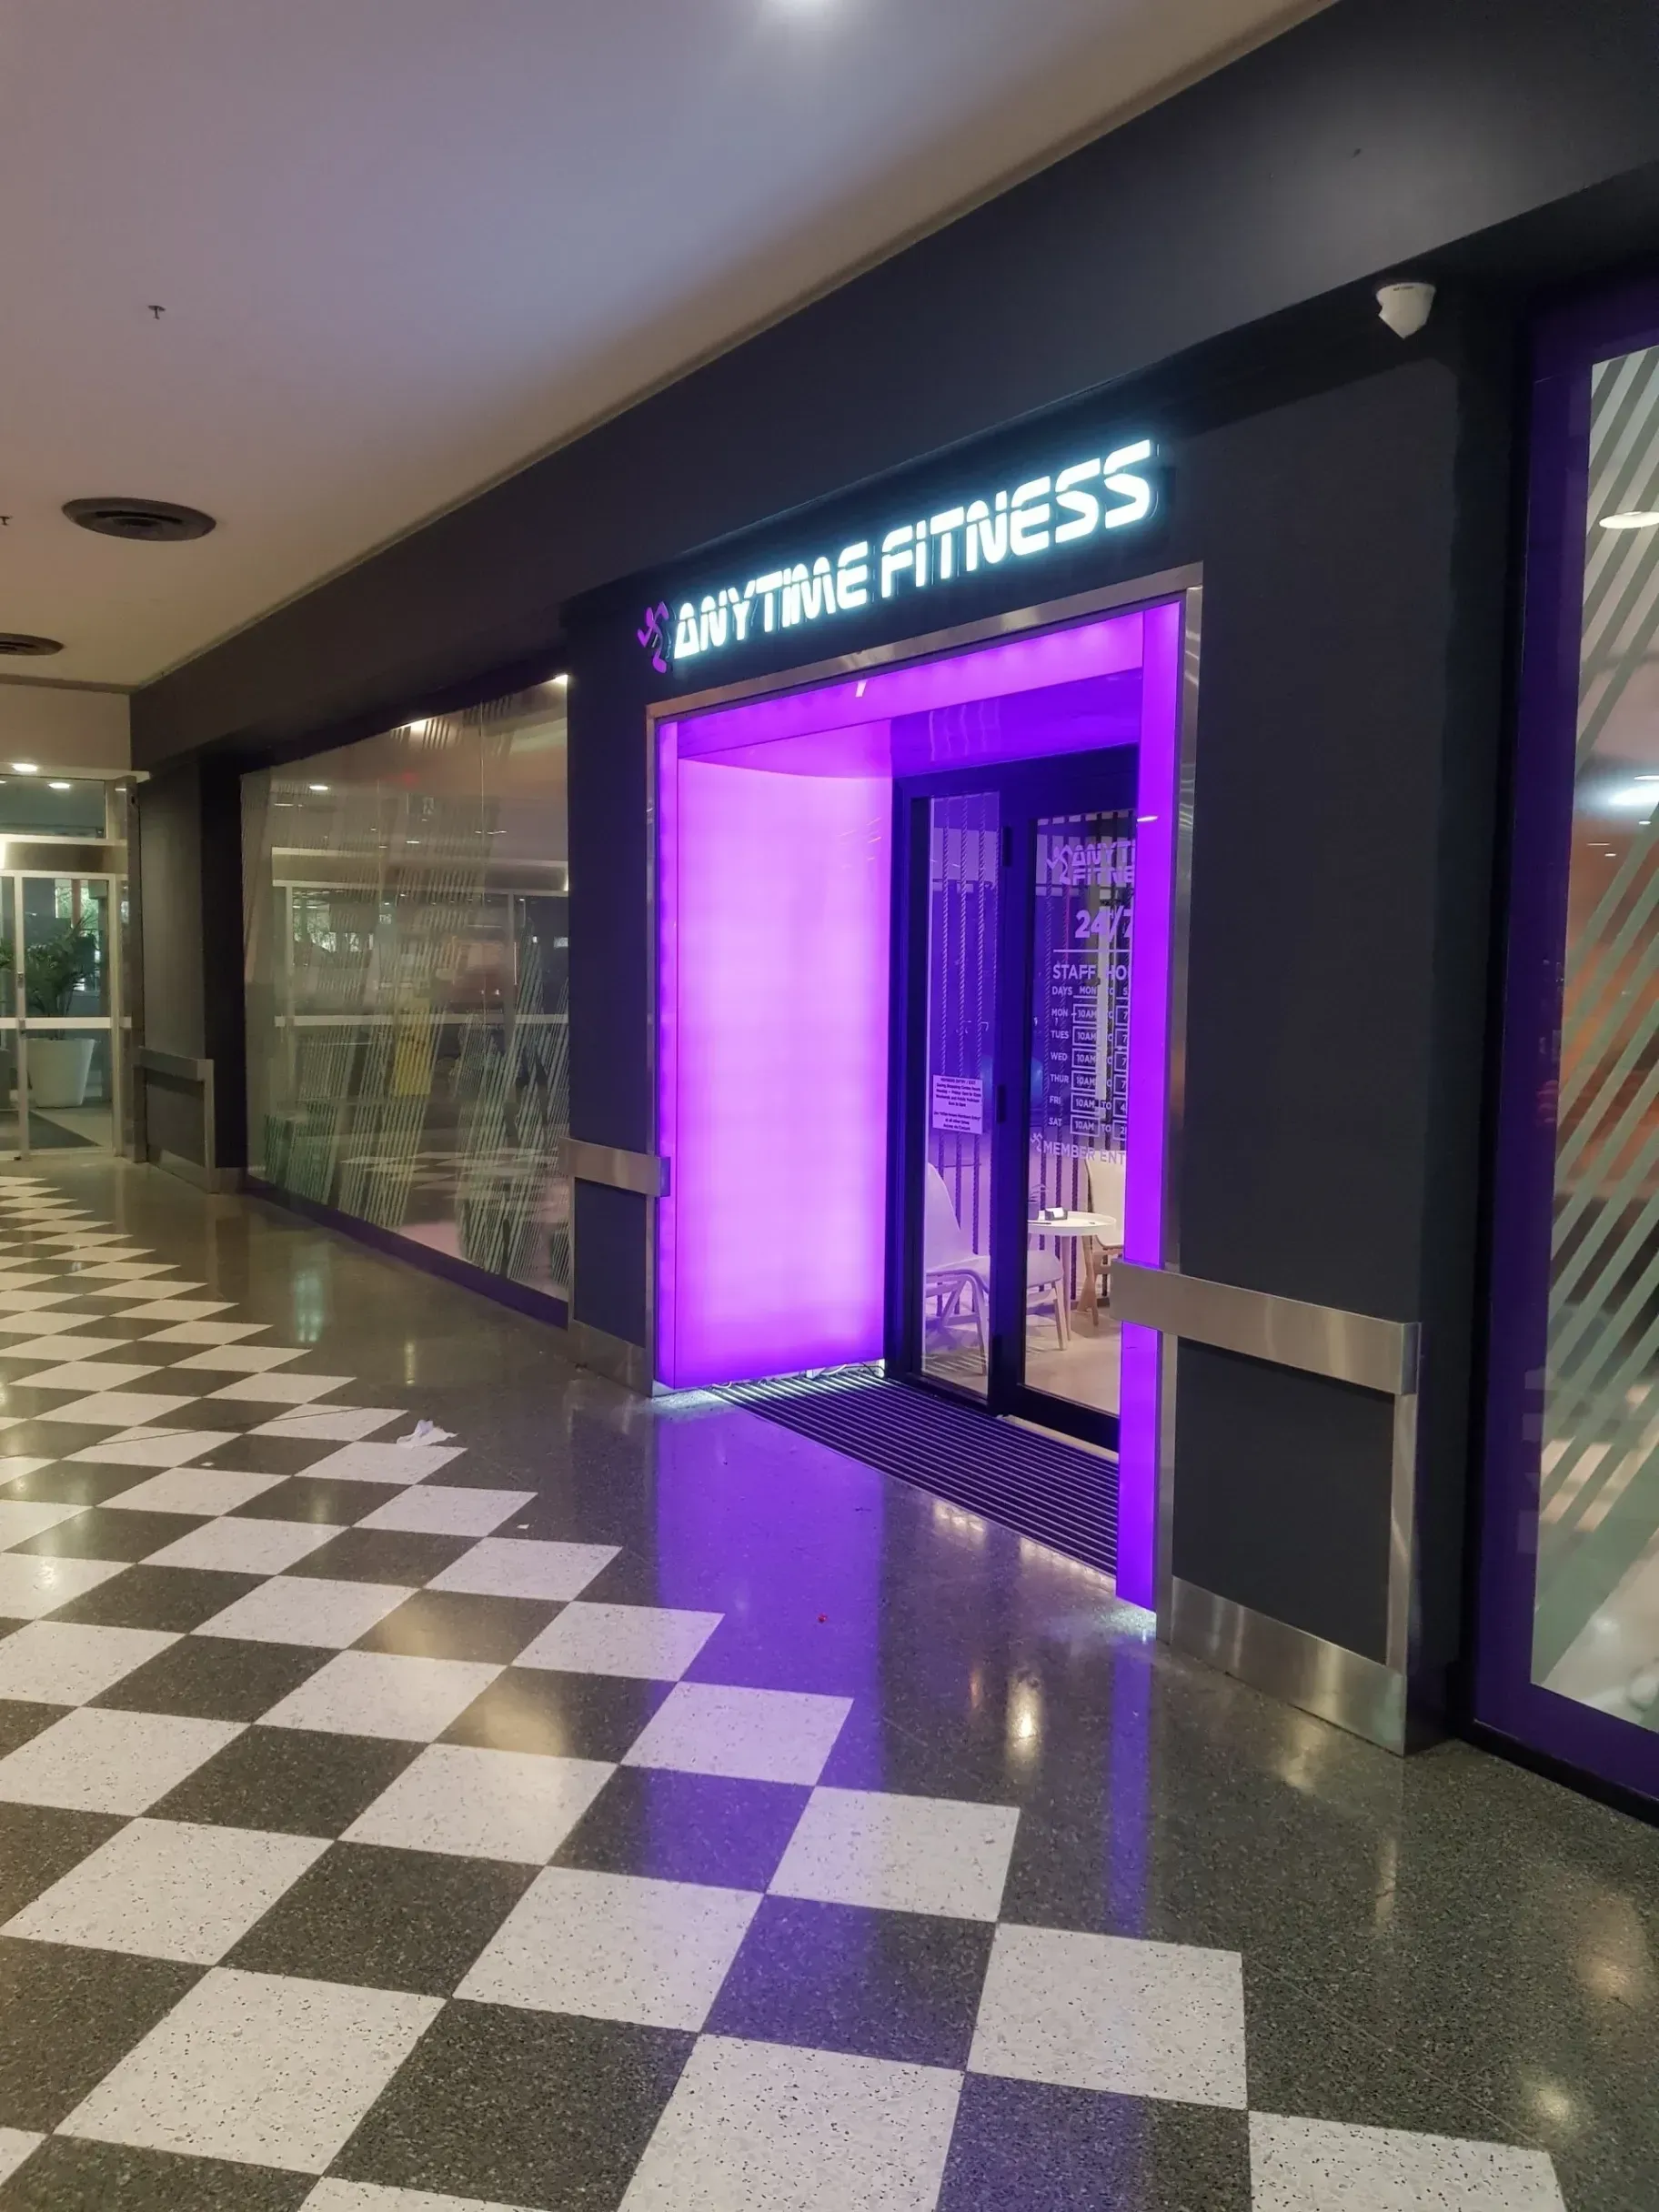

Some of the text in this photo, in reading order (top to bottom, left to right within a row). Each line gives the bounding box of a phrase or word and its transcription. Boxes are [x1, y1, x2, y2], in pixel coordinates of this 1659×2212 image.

[673, 438, 1151, 660] ANYTIME FITNESS
[1052, 964, 1097, 980] STAFF
[1051, 985, 1073, 996] DAYS
[1051, 1008, 1069, 1018] MON
[1051, 1030, 1070, 1040] TUES
[1050, 1051, 1068, 1061] WED
[1050, 1073, 1070, 1083] THUR
[1049, 1095, 1061, 1105] FRI
[1075, 1098, 1095, 1108] 10AM
[1101, 1101, 1112, 1111] TO
[1049, 1117, 1062, 1127] SAT
[1074, 1120, 1094, 1131] 10AM
[1101, 1123, 1111, 1132] TO
[1042, 1140, 1096, 1161] MEMBER
